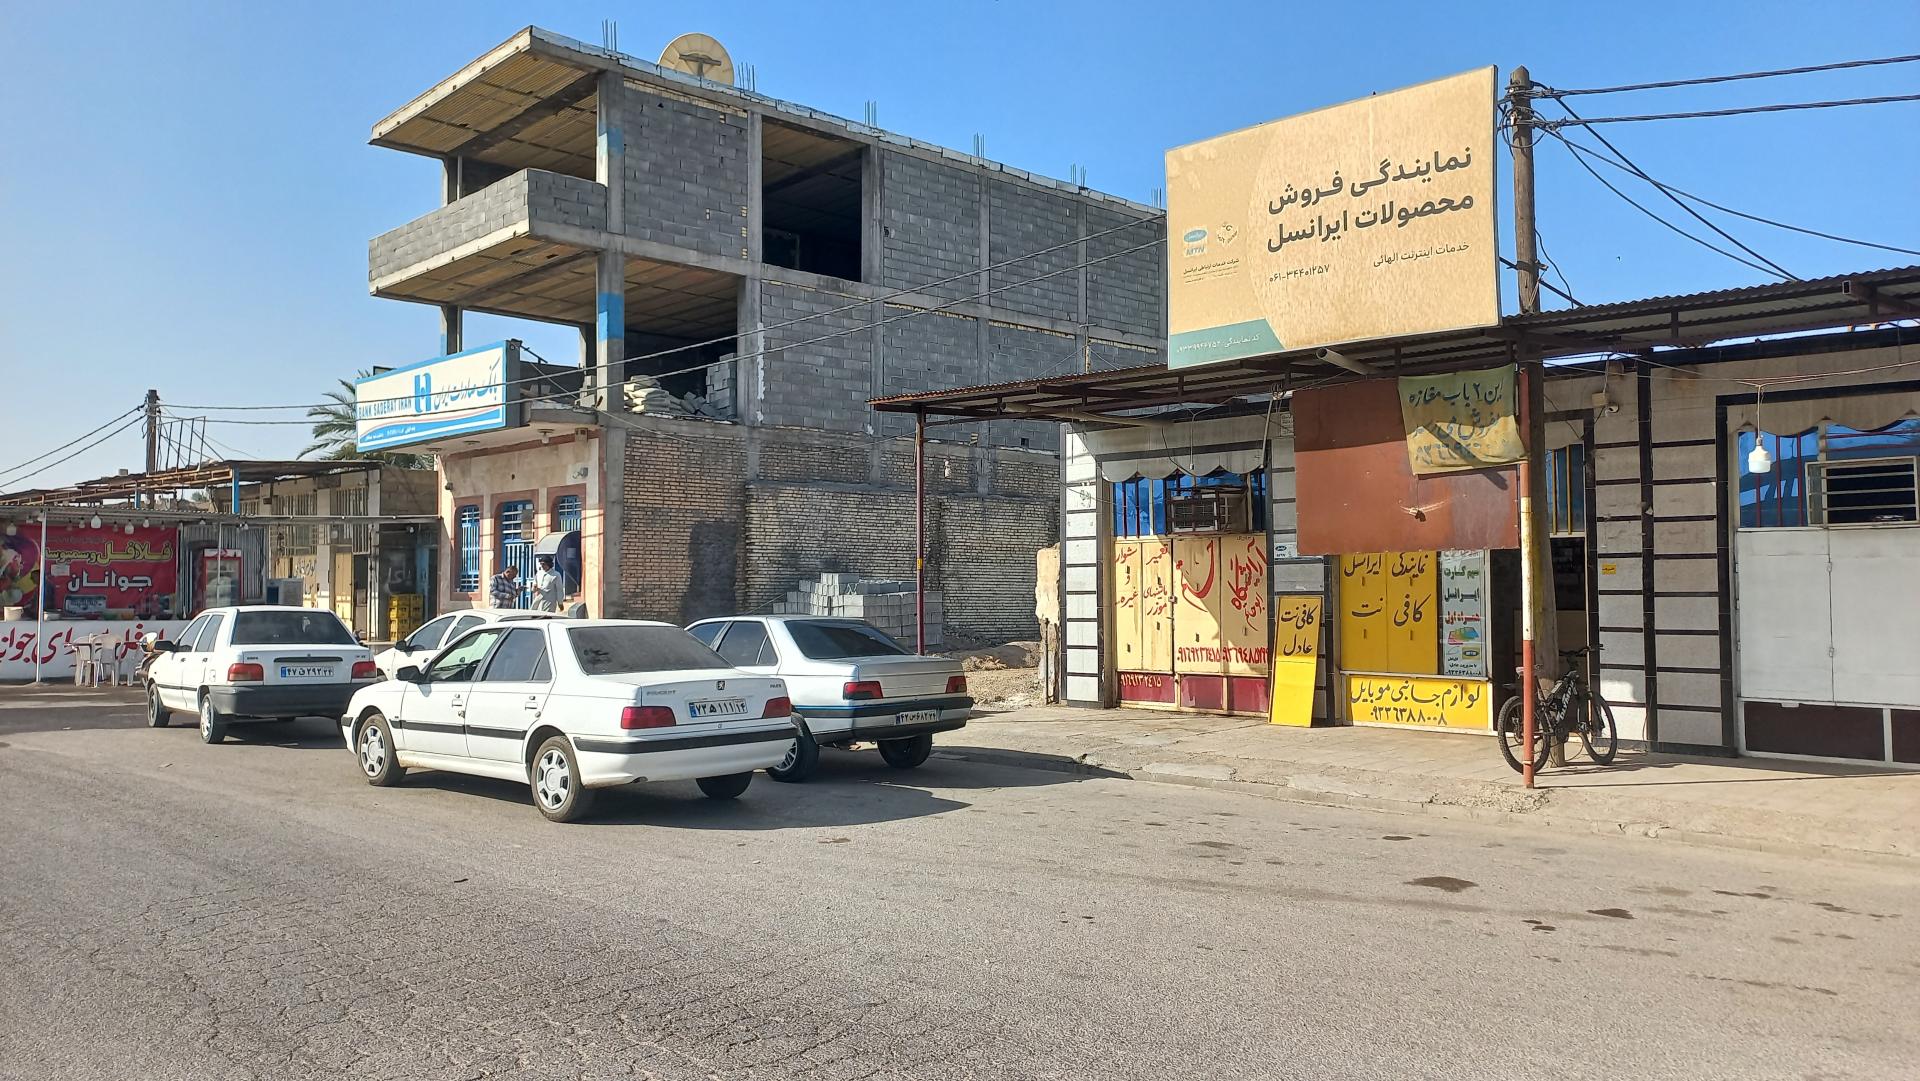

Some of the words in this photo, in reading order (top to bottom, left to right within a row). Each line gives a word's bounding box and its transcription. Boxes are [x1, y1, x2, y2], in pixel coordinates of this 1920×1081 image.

[1350, 146, 1472, 198] نمایندگی
[1268, 170, 1344, 215] فروش
[1355, 194, 1474, 229] محصولات
[1267, 210, 1348, 252] ایرانسل
[1401, 246, 1433, 262] اینترنت
[1435, 242, 1470, 256] خدمات
[97, 541, 173, 566] فلافل
[1146, 544, 1169, 565] تعمیر
[67, 569, 152, 591] جوانان
[1445, 587, 1479, 602] ایرانسل
[1281, 606, 1299, 622] نت
[1296, 604, 1318, 630] کافی
[1352, 598, 1383, 617] نت
[1393, 594, 1431, 626] کافی
[1283, 634, 1313, 656] عادل
[1351, 680, 1391, 704] موبایل
[1391, 680, 1441, 707] جانبی
[1441, 683, 1480, 711] لوازم
